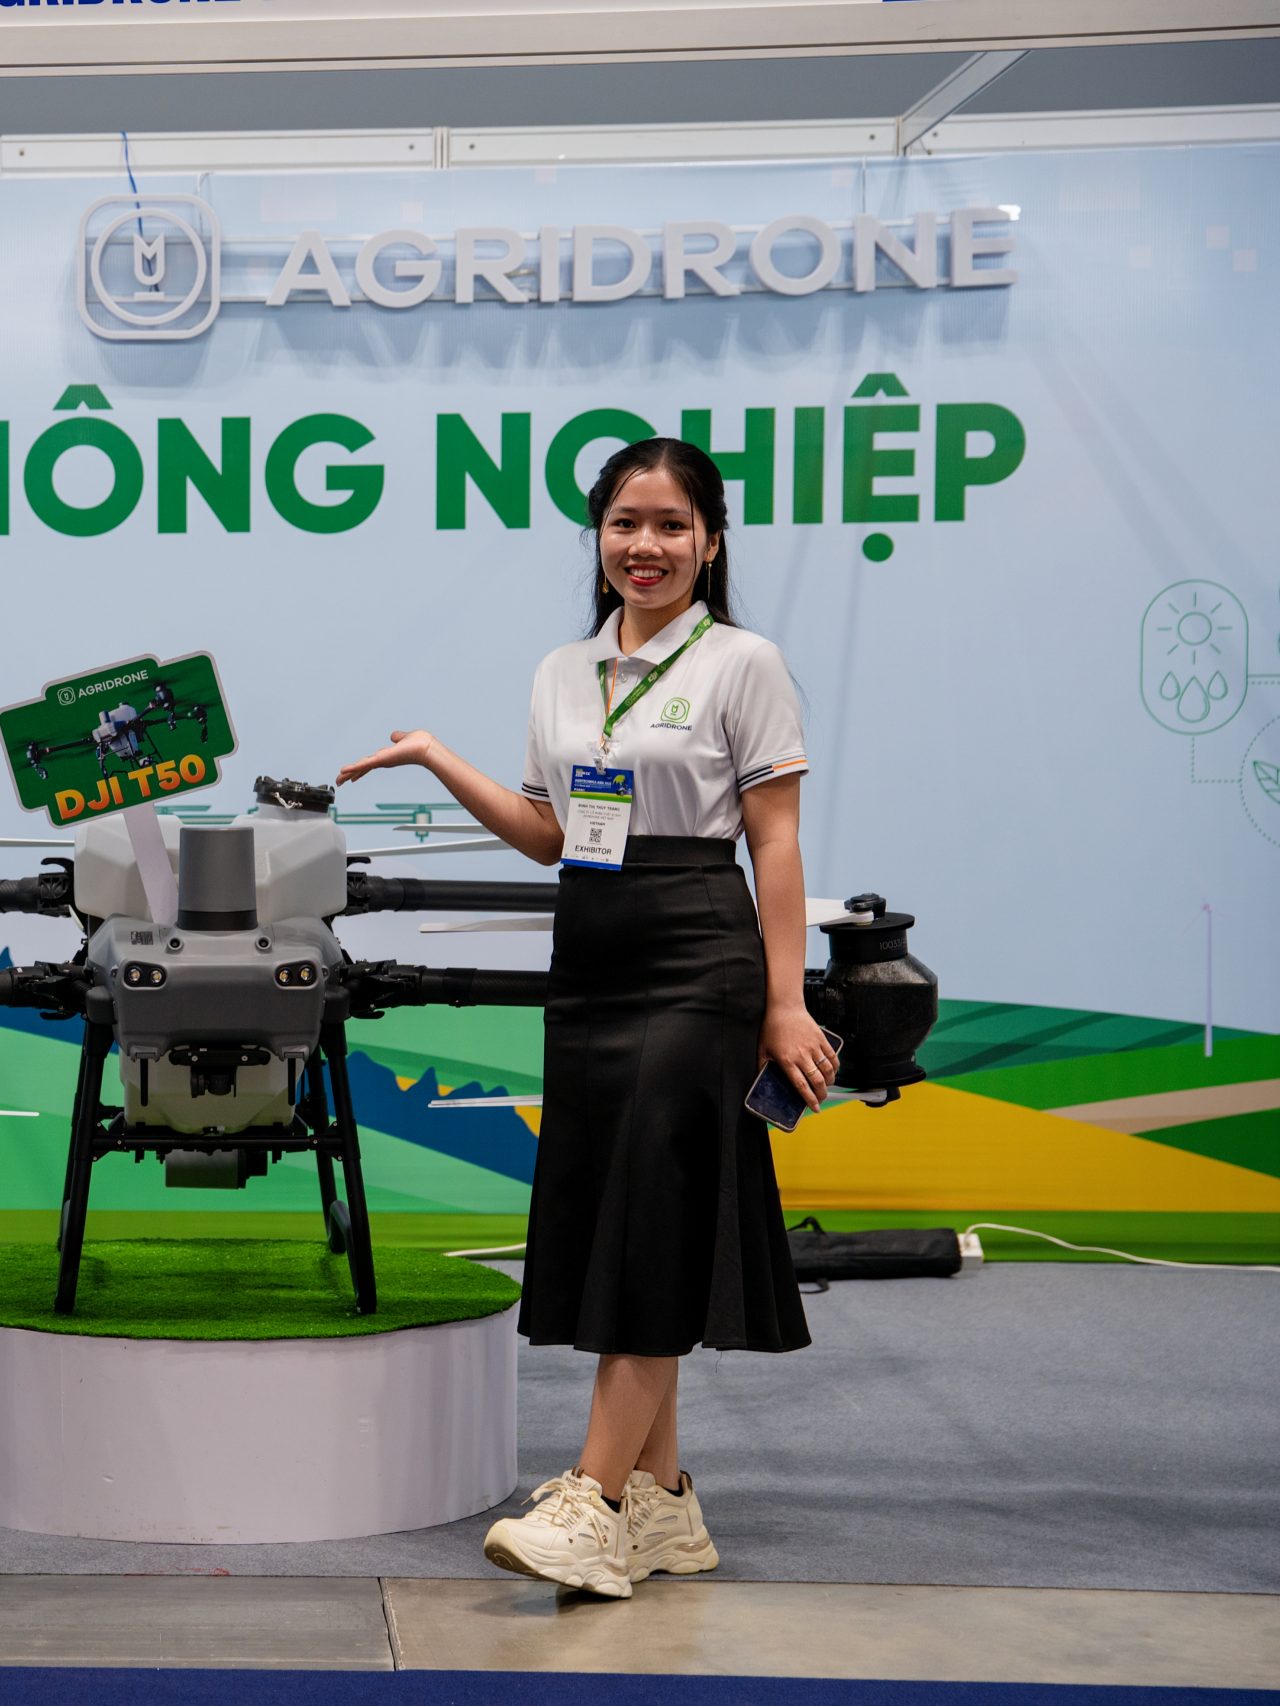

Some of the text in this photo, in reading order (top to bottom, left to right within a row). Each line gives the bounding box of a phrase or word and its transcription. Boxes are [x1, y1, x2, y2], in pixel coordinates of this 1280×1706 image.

[265, 206, 1020, 308] AGRIDRONE
[78, 670, 149, 698] AGRIDRONE
[650, 722, 692, 731] AGRIDRONE
[55, 754, 206, 820] DJI T50
[574, 844, 613, 856] EXHIBITOR
